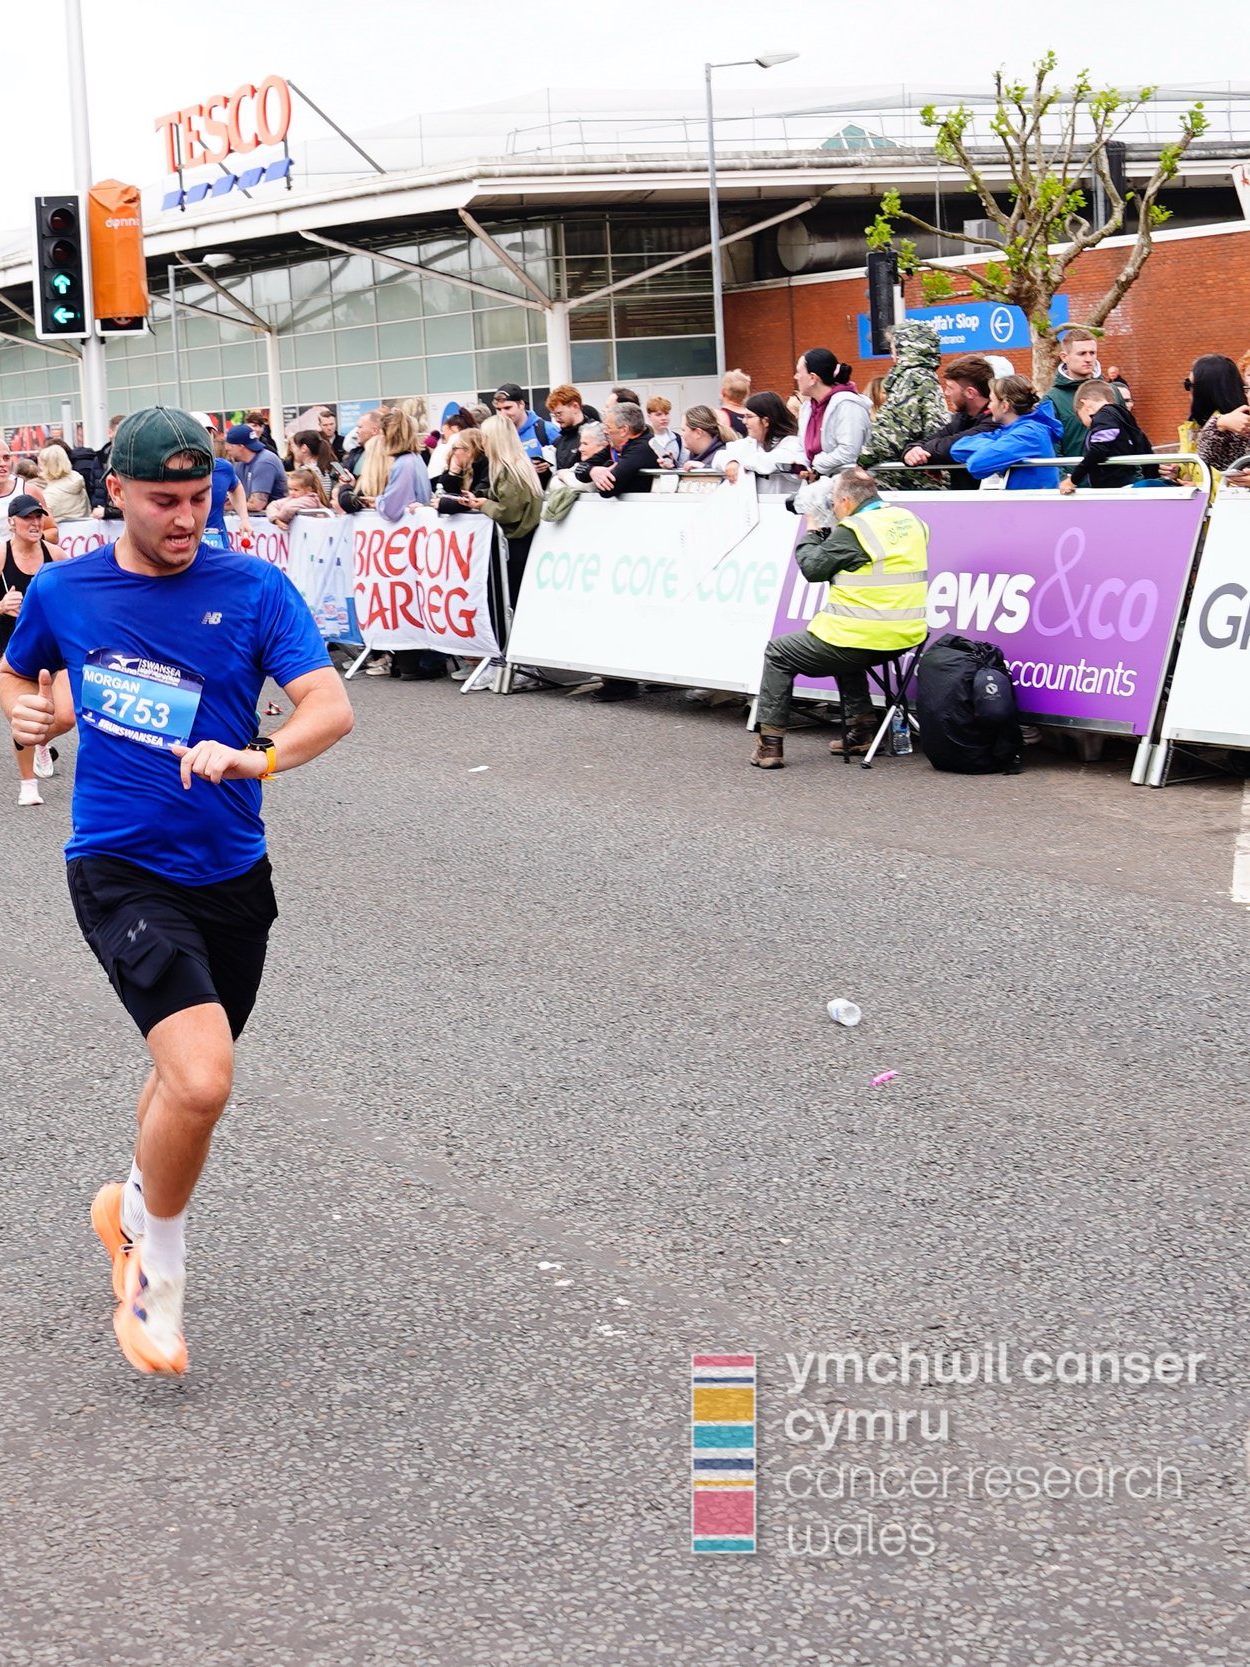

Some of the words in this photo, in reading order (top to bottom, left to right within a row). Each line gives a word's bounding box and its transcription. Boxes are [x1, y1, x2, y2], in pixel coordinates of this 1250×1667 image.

[154, 75, 292, 175] TESCO
[955, 313, 980, 331] Siop
[354, 526, 475, 582] BRECON
[535, 551, 601, 592] core
[353, 580, 478, 638] CARREG
[84, 669, 141, 694] MORGAN
[140, 659, 182, 678] SWANSEA
[101, 688, 171, 729] 2753
